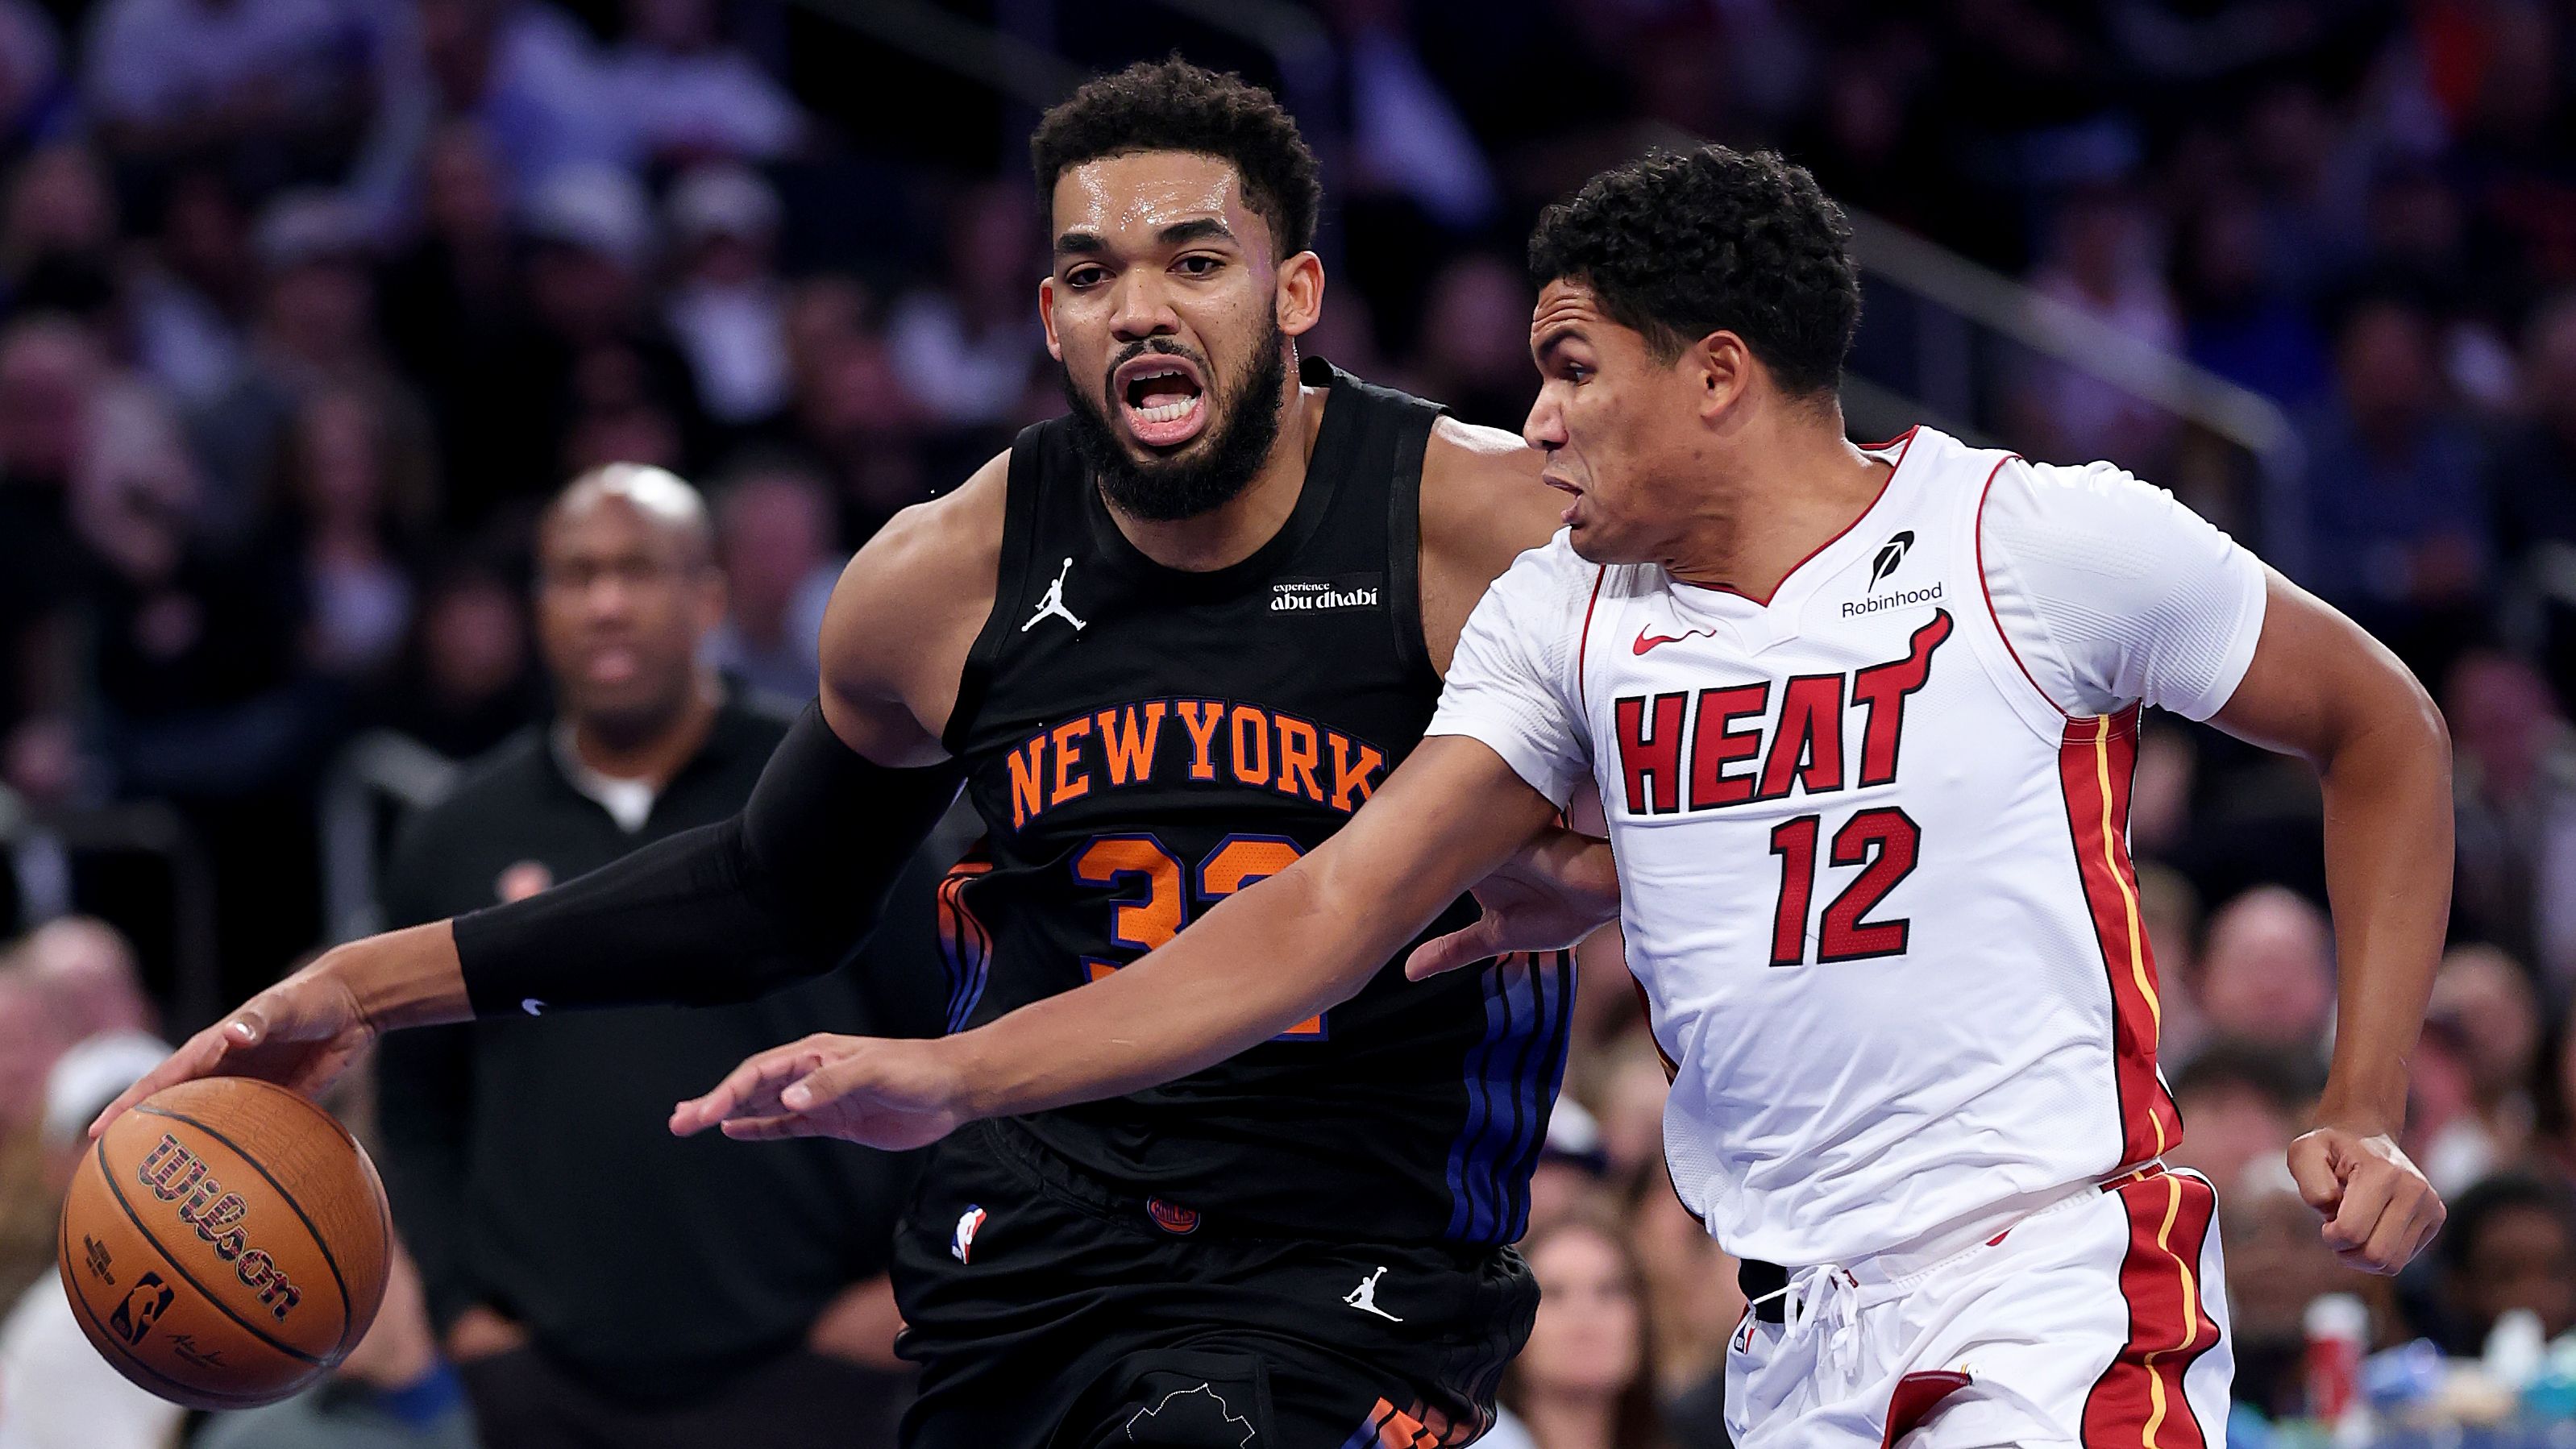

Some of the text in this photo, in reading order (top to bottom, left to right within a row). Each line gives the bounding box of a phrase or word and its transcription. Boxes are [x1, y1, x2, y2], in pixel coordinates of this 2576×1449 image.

[1270, 587, 1377, 610] abu dhabi
[1273, 582, 1330, 592] experience
[1841, 582, 1942, 618] Robinhood
[1006, 698, 1386, 833] NEW YORK
[1614, 608, 1954, 816] HEAT
[1769, 806, 1922, 967] 12
[138, 1133, 301, 1322] Wilson
